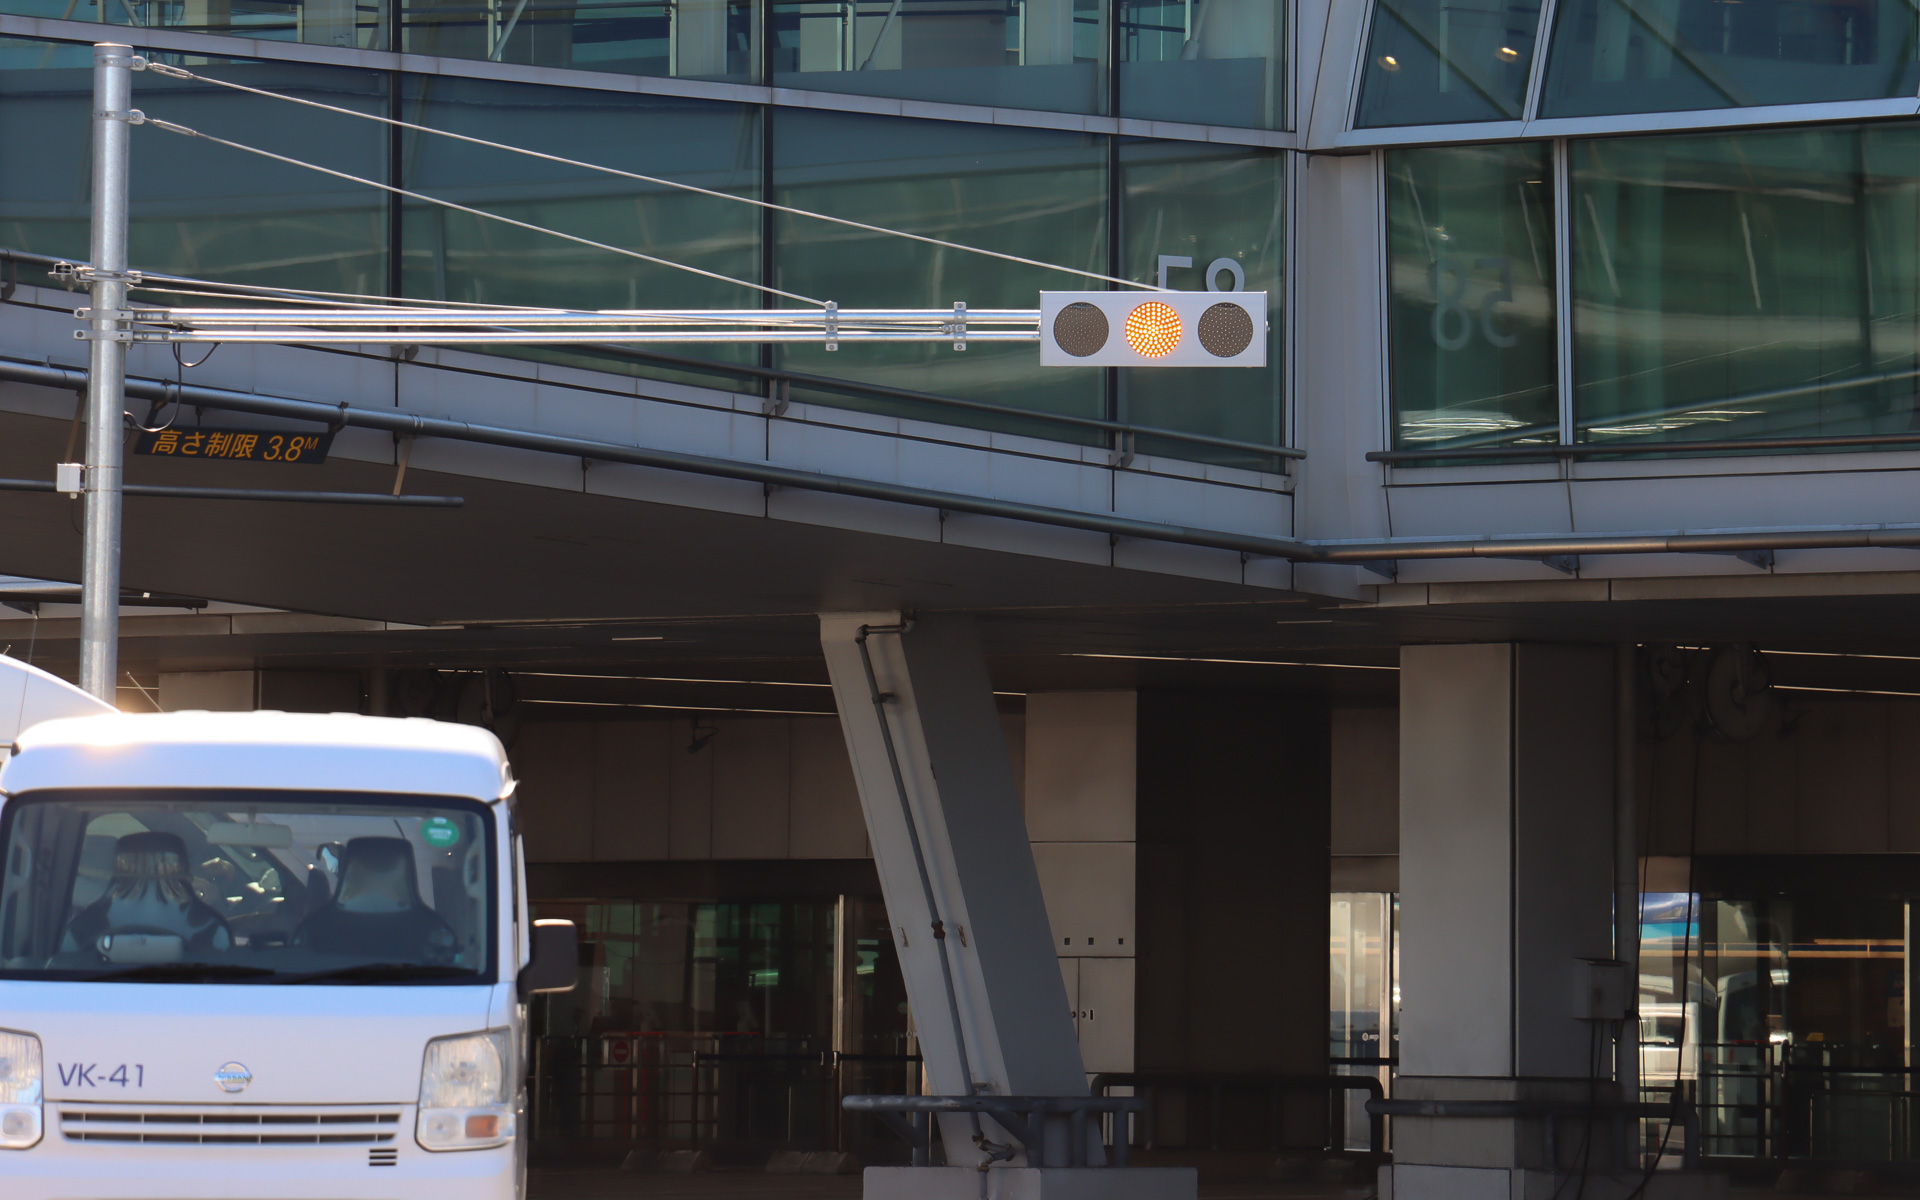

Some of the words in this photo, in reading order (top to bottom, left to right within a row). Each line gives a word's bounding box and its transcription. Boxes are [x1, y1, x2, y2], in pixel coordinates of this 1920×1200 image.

[152, 429, 259, 459] 高さ制限
[57, 1063, 144, 1087] VK-41
